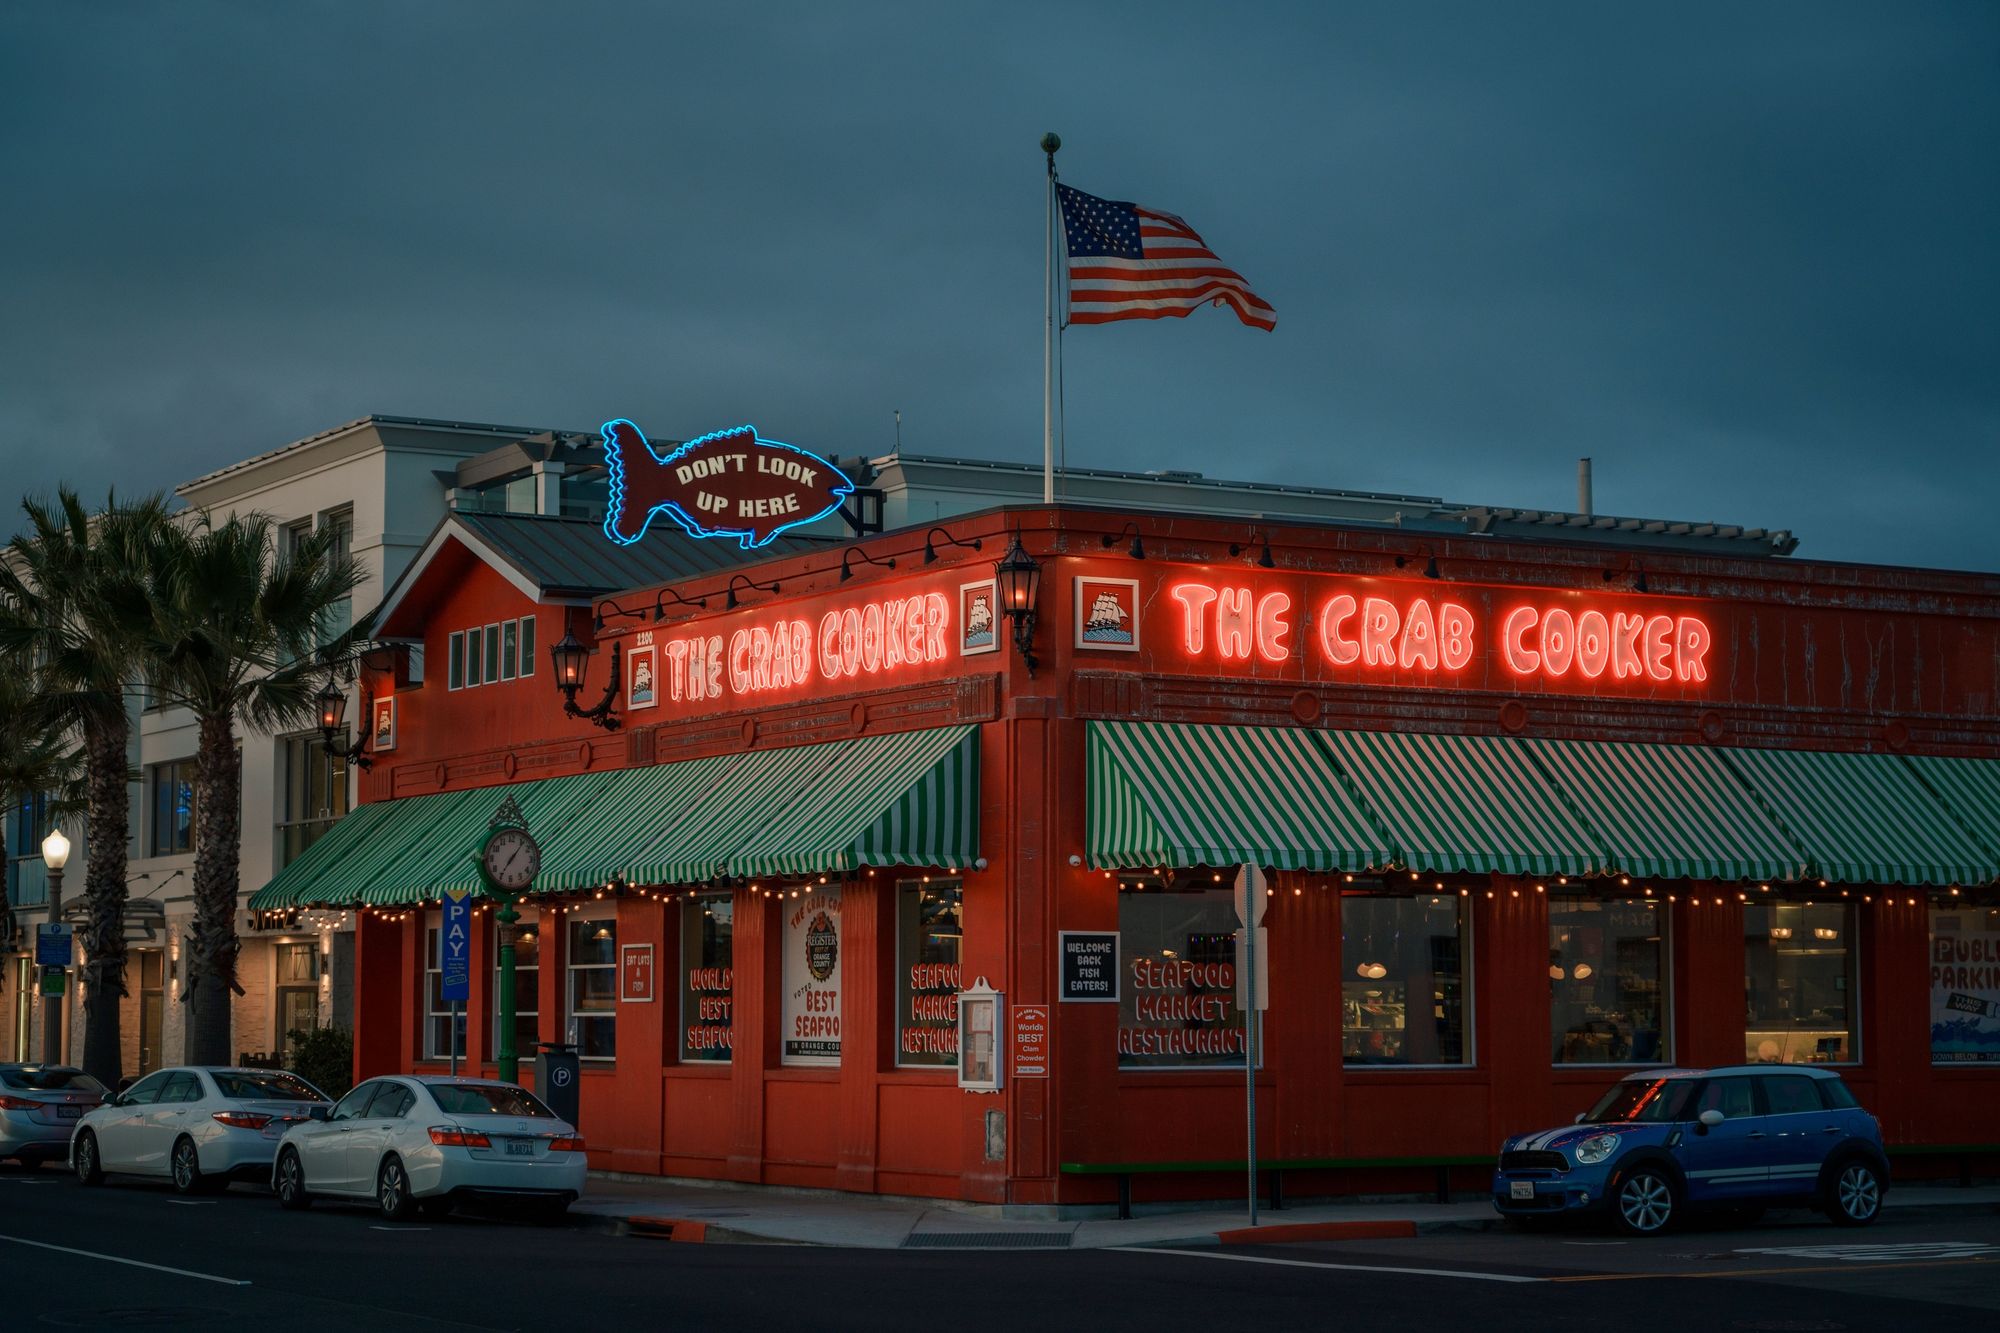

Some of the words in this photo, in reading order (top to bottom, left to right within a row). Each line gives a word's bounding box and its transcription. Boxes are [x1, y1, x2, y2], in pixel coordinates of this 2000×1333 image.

[675, 454, 747, 486] DON'T
[758, 455, 818, 488] LOOK
[696, 491, 729, 515] UP
[738, 492, 800, 518] HERE
[637, 631, 653, 644] 2200
[1171, 583, 1291, 662] THE
[1320, 594, 1474, 671] CRAB
[1502, 605, 1711, 683] COOKER
[665, 635, 723, 702] THE
[728, 620, 811, 695] CRAB
[818, 593, 949, 680] COOKER
[790, 907, 805, 929] THE
[448, 905, 465, 957] PAY
[807, 935, 836, 946] REGISTER
[1067, 942, 1112, 953] WELCOME
[626, 954, 637, 966] EAT
[813, 960, 830, 968] COUNTY
[1077, 955, 1102, 966] BACK
[636, 967, 641, 977] A
[1079, 967, 1100, 978] FISH
[1134, 961, 1234, 989] SEAFOOD
[793, 982, 812, 999] VOTED
[1071, 980, 1109, 992] EATERS!
[806, 990, 837, 1012] BEST
[911, 994, 958, 1021] MARKE
[1955, 1002, 1980, 1012] WAY
[699, 996, 732, 1020] BEST
[1136, 994, 1233, 1022] MARKET
[1017, 1033, 1044, 1043] BEST
[1118, 1027, 1247, 1055] RESTAURANT
[801, 1042, 825, 1050] ORANGE
[1016, 1054, 1045, 1062] Chowder
[1932, 1053, 1953, 1061] DOWN
[1955, 1053, 1978, 1061] BELOW
